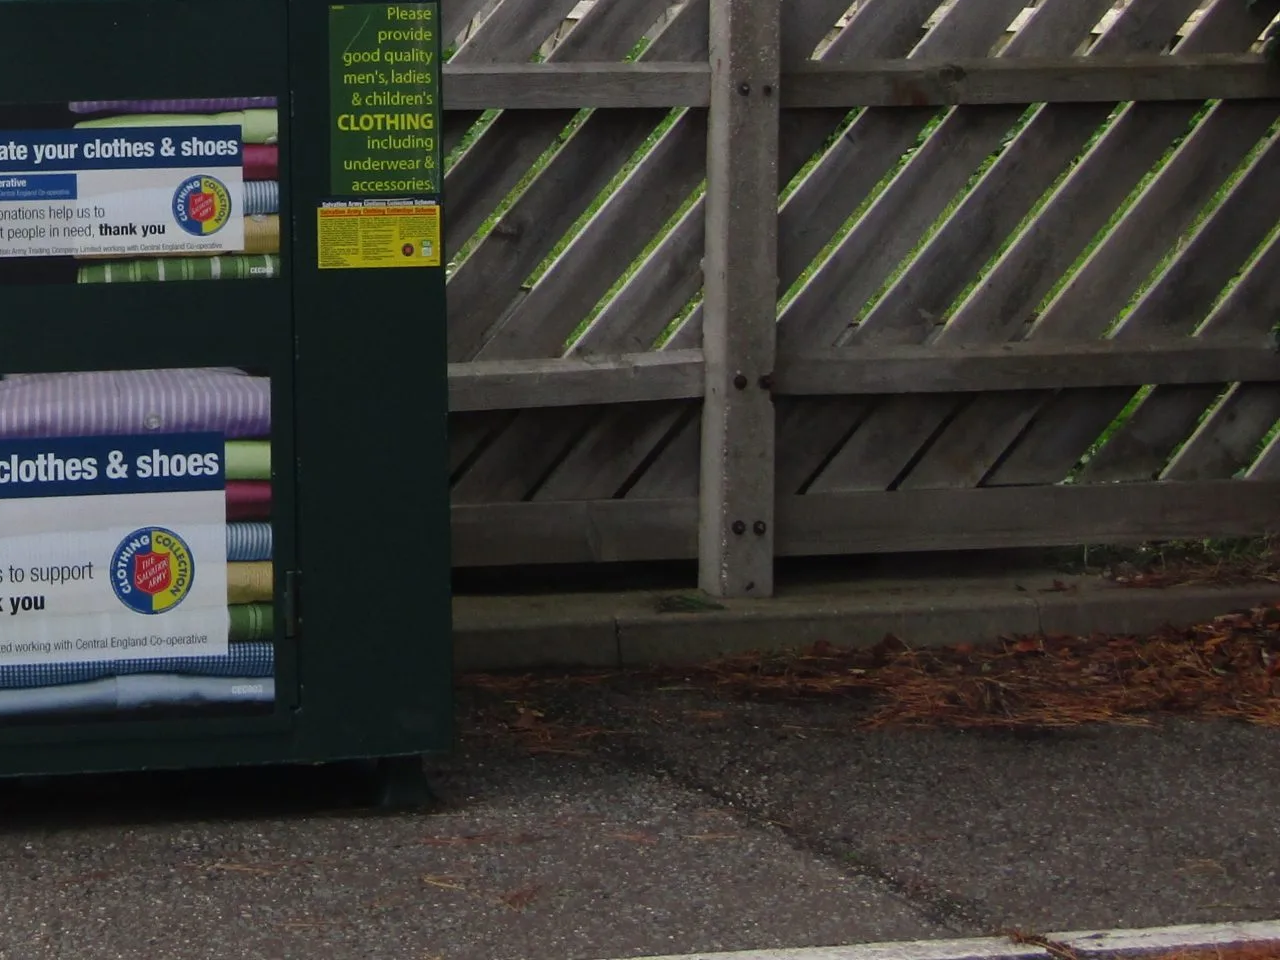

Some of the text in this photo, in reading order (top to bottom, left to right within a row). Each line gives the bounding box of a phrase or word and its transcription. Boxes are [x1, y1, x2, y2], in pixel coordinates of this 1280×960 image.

[387, 7, 432, 21] Please
[378, 28, 432, 44] provide
[343, 49, 433, 66] good quality
[343, 70, 431, 86] men's, ladies
[352, 91, 433, 105] & children's
[337, 113, 434, 131] CLOTHING
[33, 143, 78, 164] your
[83, 138, 154, 159] clothes
[160, 137, 175, 156] &
[181, 137, 238, 156] shoes
[367, 135, 433, 152] including
[343, 156, 435, 171] underwear &
[352, 178, 434, 191] accessories.
[177, 180, 200, 221] CLOTHING
[204, 180, 226, 223] COLLECTION
[49, 205, 73, 221] help
[77, 207, 90, 218] us
[94, 205, 105, 218] to
[7, 225, 46, 240] people
[49, 224, 60, 237] in
[63, 224, 95, 239] need,
[99, 223, 137, 236] thank
[142, 224, 166, 237] you
[106, 450, 128, 479] &
[136, 449, 219, 477] shoes
[10, 565, 24, 583] to
[31, 562, 94, 585] support
[117, 535, 187, 596] CLOTHING COLLECTION
[10, 595, 45, 616] you
[15, 640, 50, 654] working
[54, 639, 73, 651] with
[75, 637, 108, 649] Central
[110, 636, 147, 649] England
[150, 635, 207, 646] Co-operative
